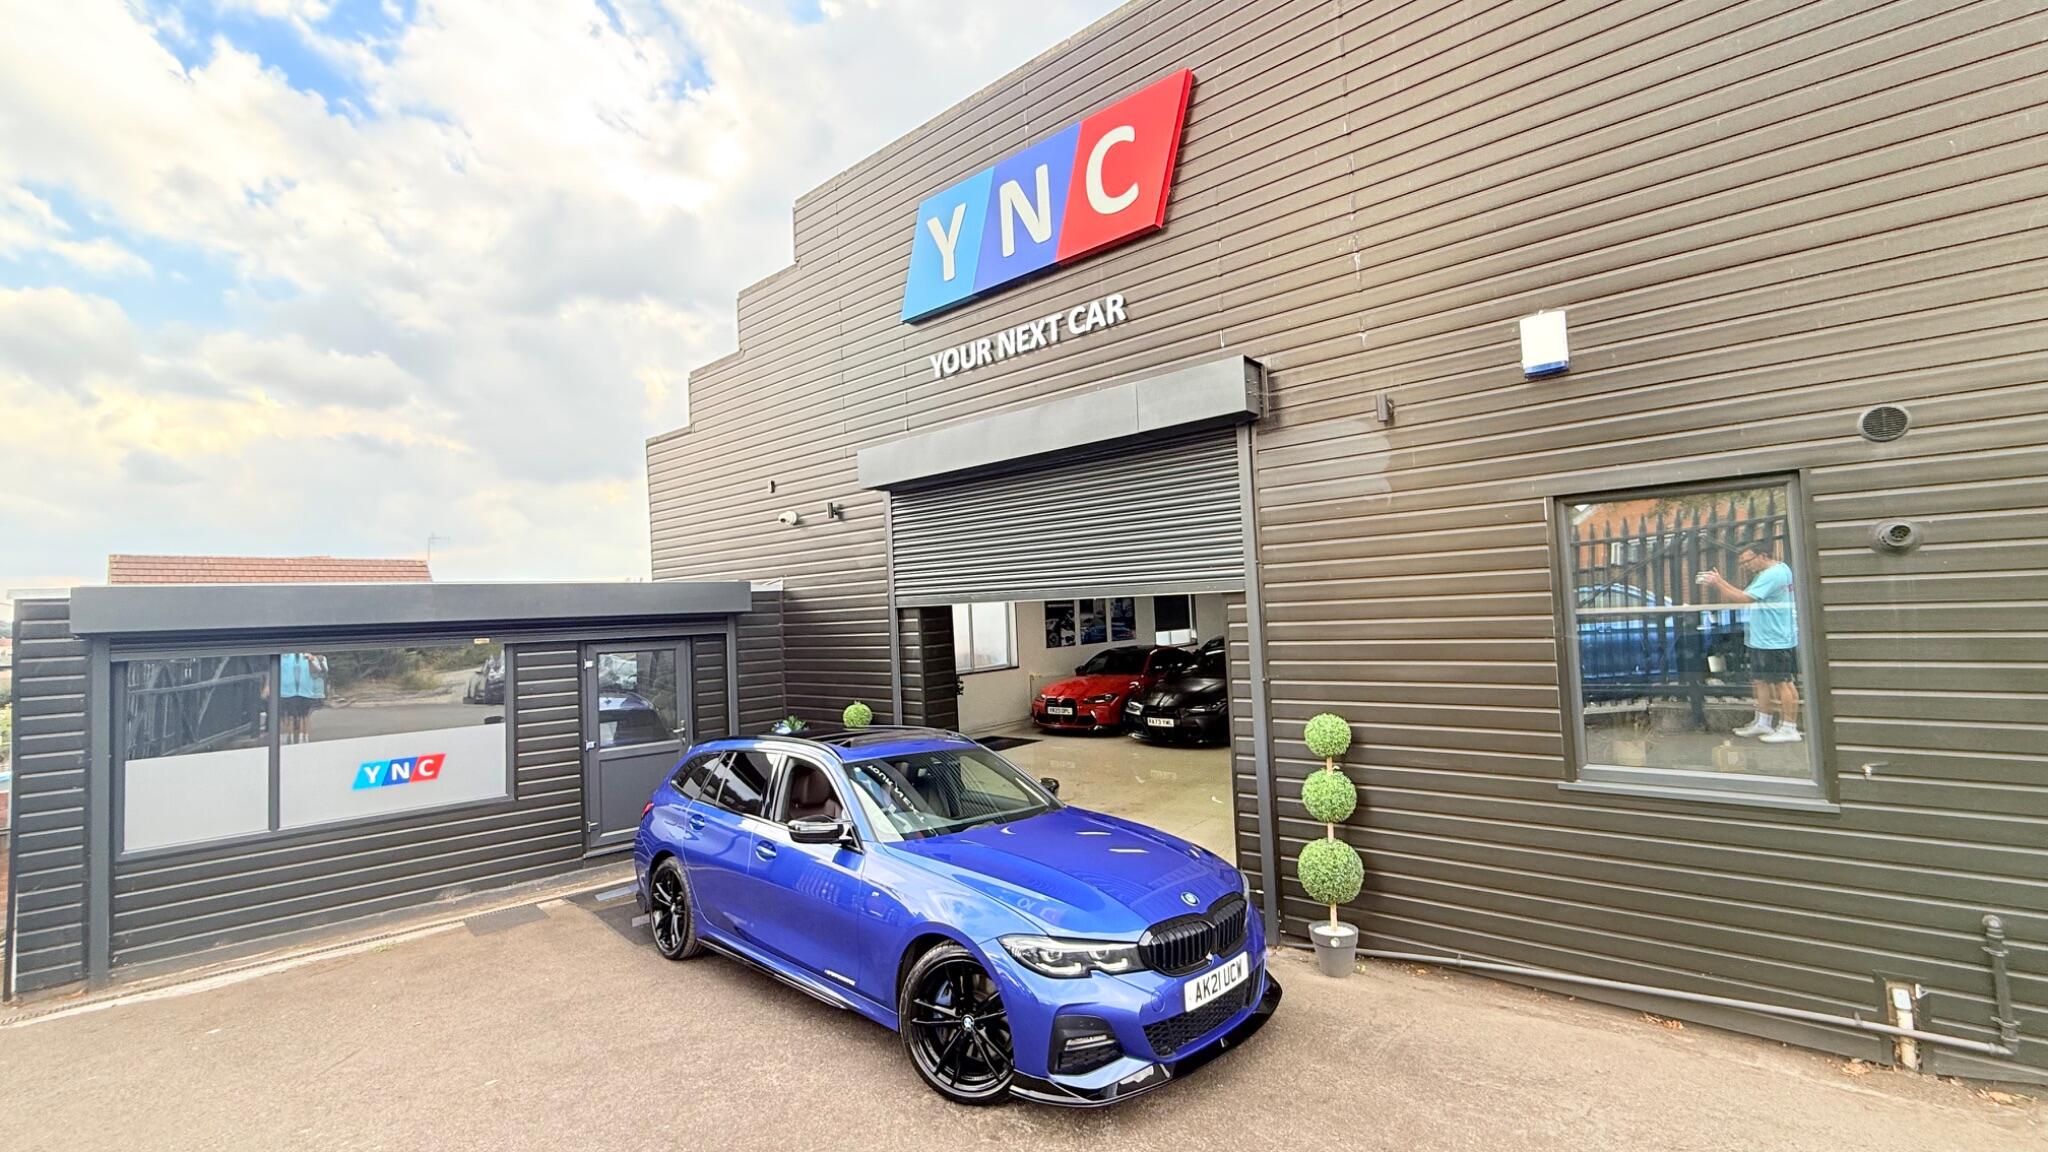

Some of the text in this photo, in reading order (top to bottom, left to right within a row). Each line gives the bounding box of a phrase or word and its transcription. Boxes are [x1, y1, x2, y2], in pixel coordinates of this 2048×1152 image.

[926, 125, 1139, 282] YNC
[930, 293, 1126, 379] YOUR NEXT CAR
[363, 759, 434, 784] YNC
[1195, 959, 1242, 1003] AK21 UCW
